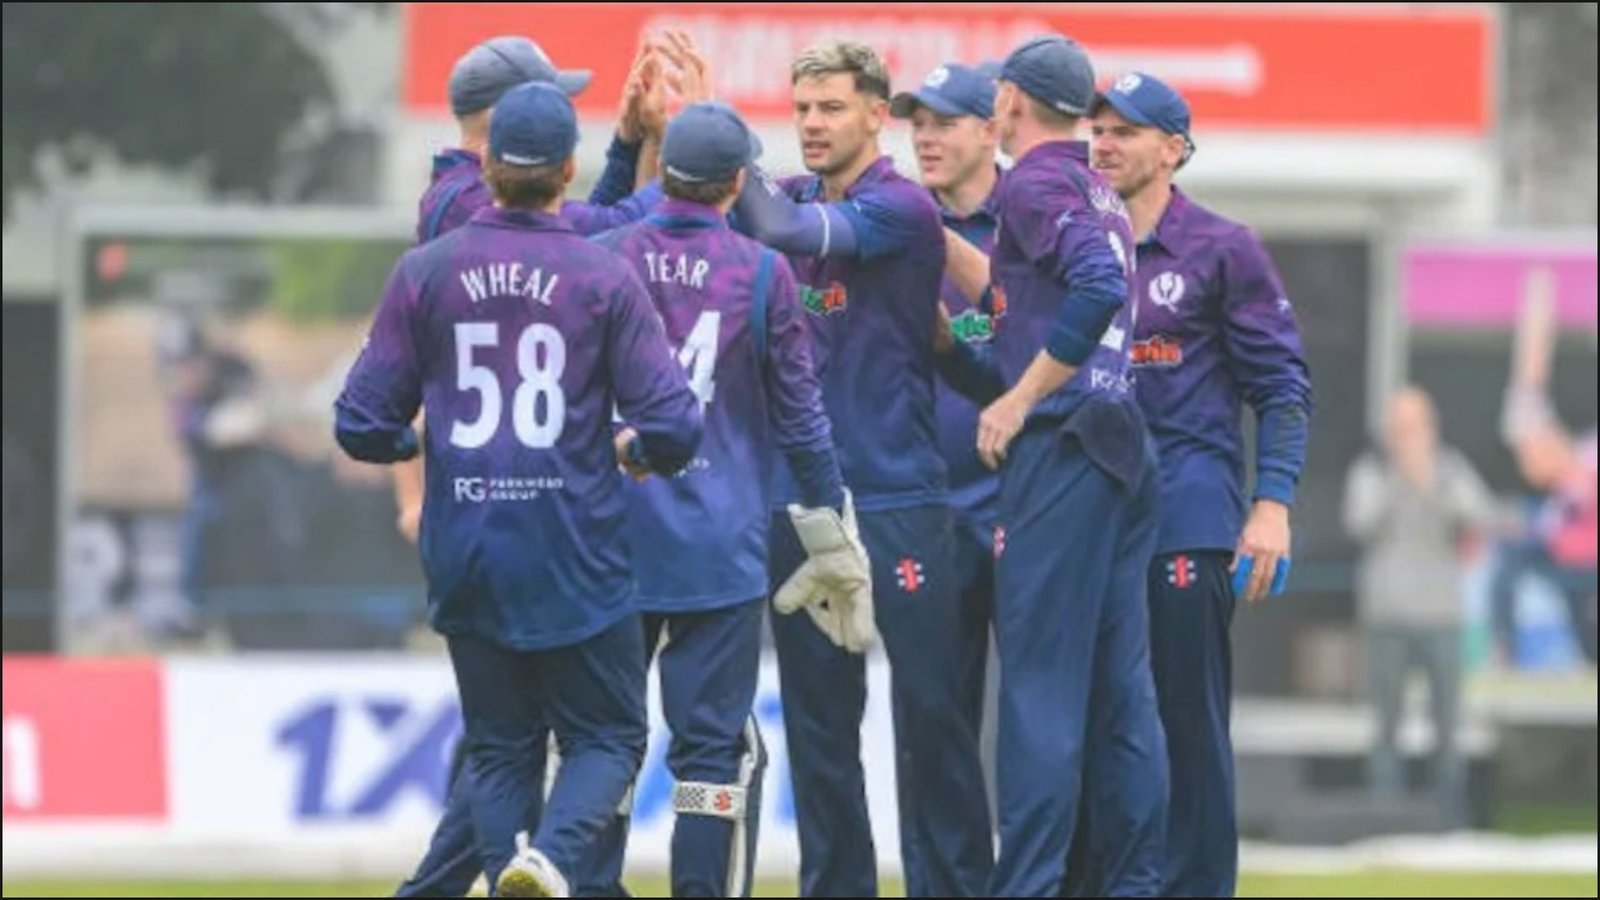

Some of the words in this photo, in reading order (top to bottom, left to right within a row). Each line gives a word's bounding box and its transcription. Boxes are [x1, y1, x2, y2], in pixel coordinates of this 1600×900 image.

[460, 262, 559, 306] WHEAL
[644, 251, 710, 289] TEAR
[449, 321, 567, 449] 58
